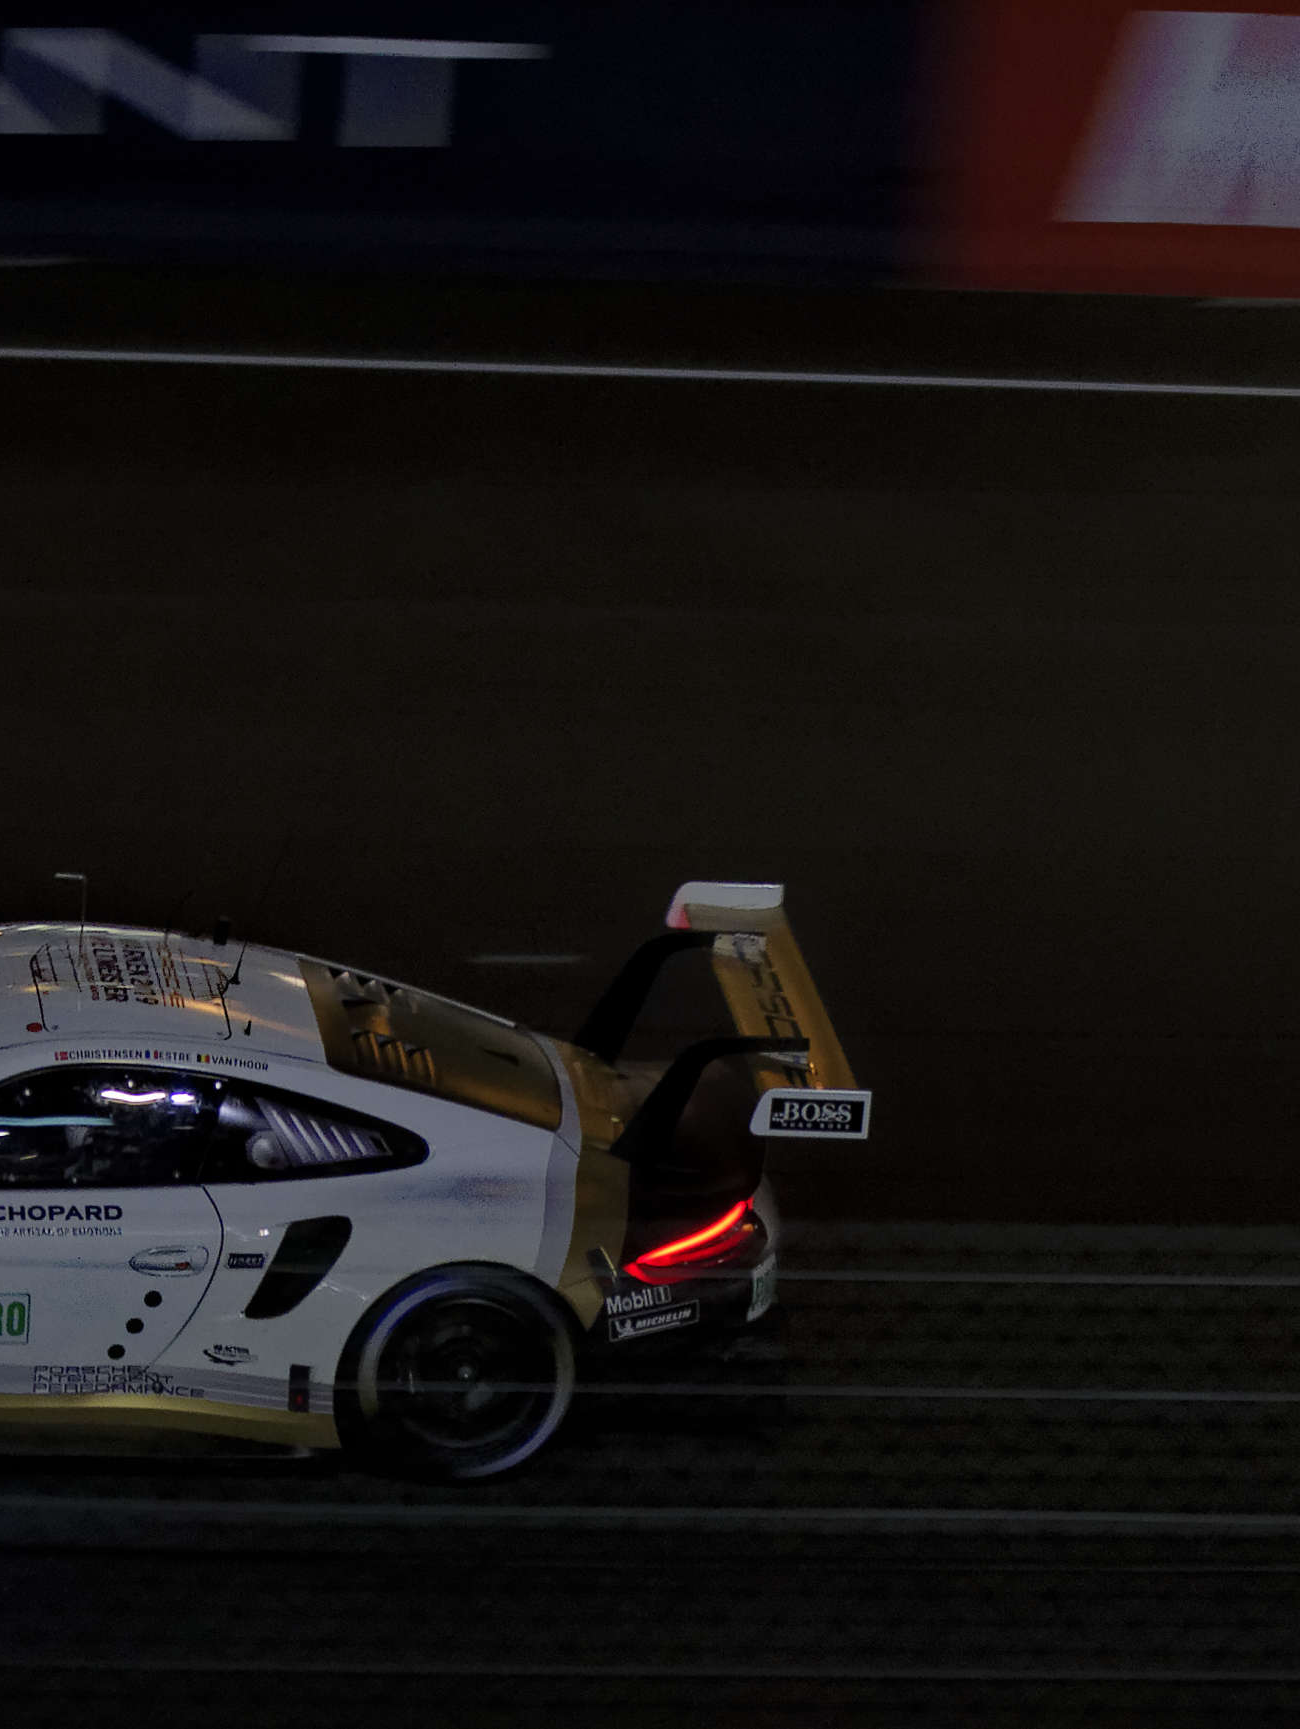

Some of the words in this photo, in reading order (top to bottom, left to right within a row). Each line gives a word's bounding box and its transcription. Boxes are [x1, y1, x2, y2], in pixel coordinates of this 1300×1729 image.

[212, 1054, 270, 1072] VANTHOOR
[783, 1101, 853, 1124] BOSS
[606, 1287, 653, 1315] Mobil
[636, 1307, 692, 1329] MICHELIN
